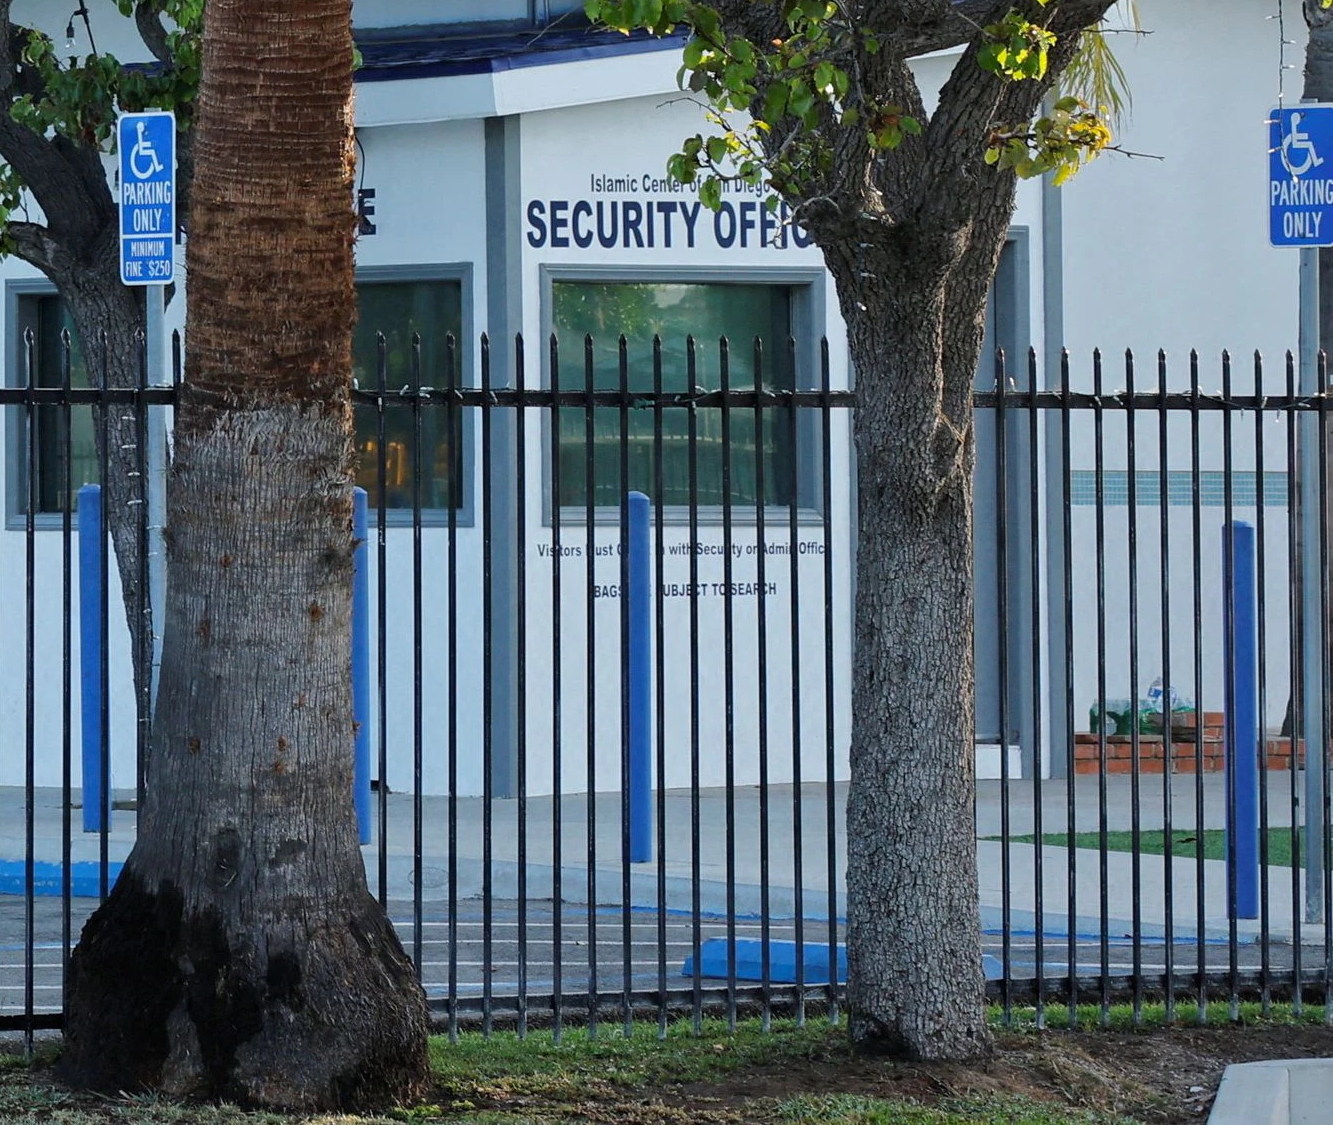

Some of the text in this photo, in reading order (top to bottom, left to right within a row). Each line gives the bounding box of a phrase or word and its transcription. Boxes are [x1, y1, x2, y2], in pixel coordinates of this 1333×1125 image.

[123, 181, 171, 206] PARKING
[591, 173, 638, 193] Islamic
[1271, 179, 1333, 206] PARKING
[133, 208, 162, 232] ONLY
[527, 200, 813, 249] SECURITY OFFIC
[1283, 212, 1322, 238] ONLY
[131, 240, 165, 257] MINIMUM
[125, 260, 171, 278] FINE $250
